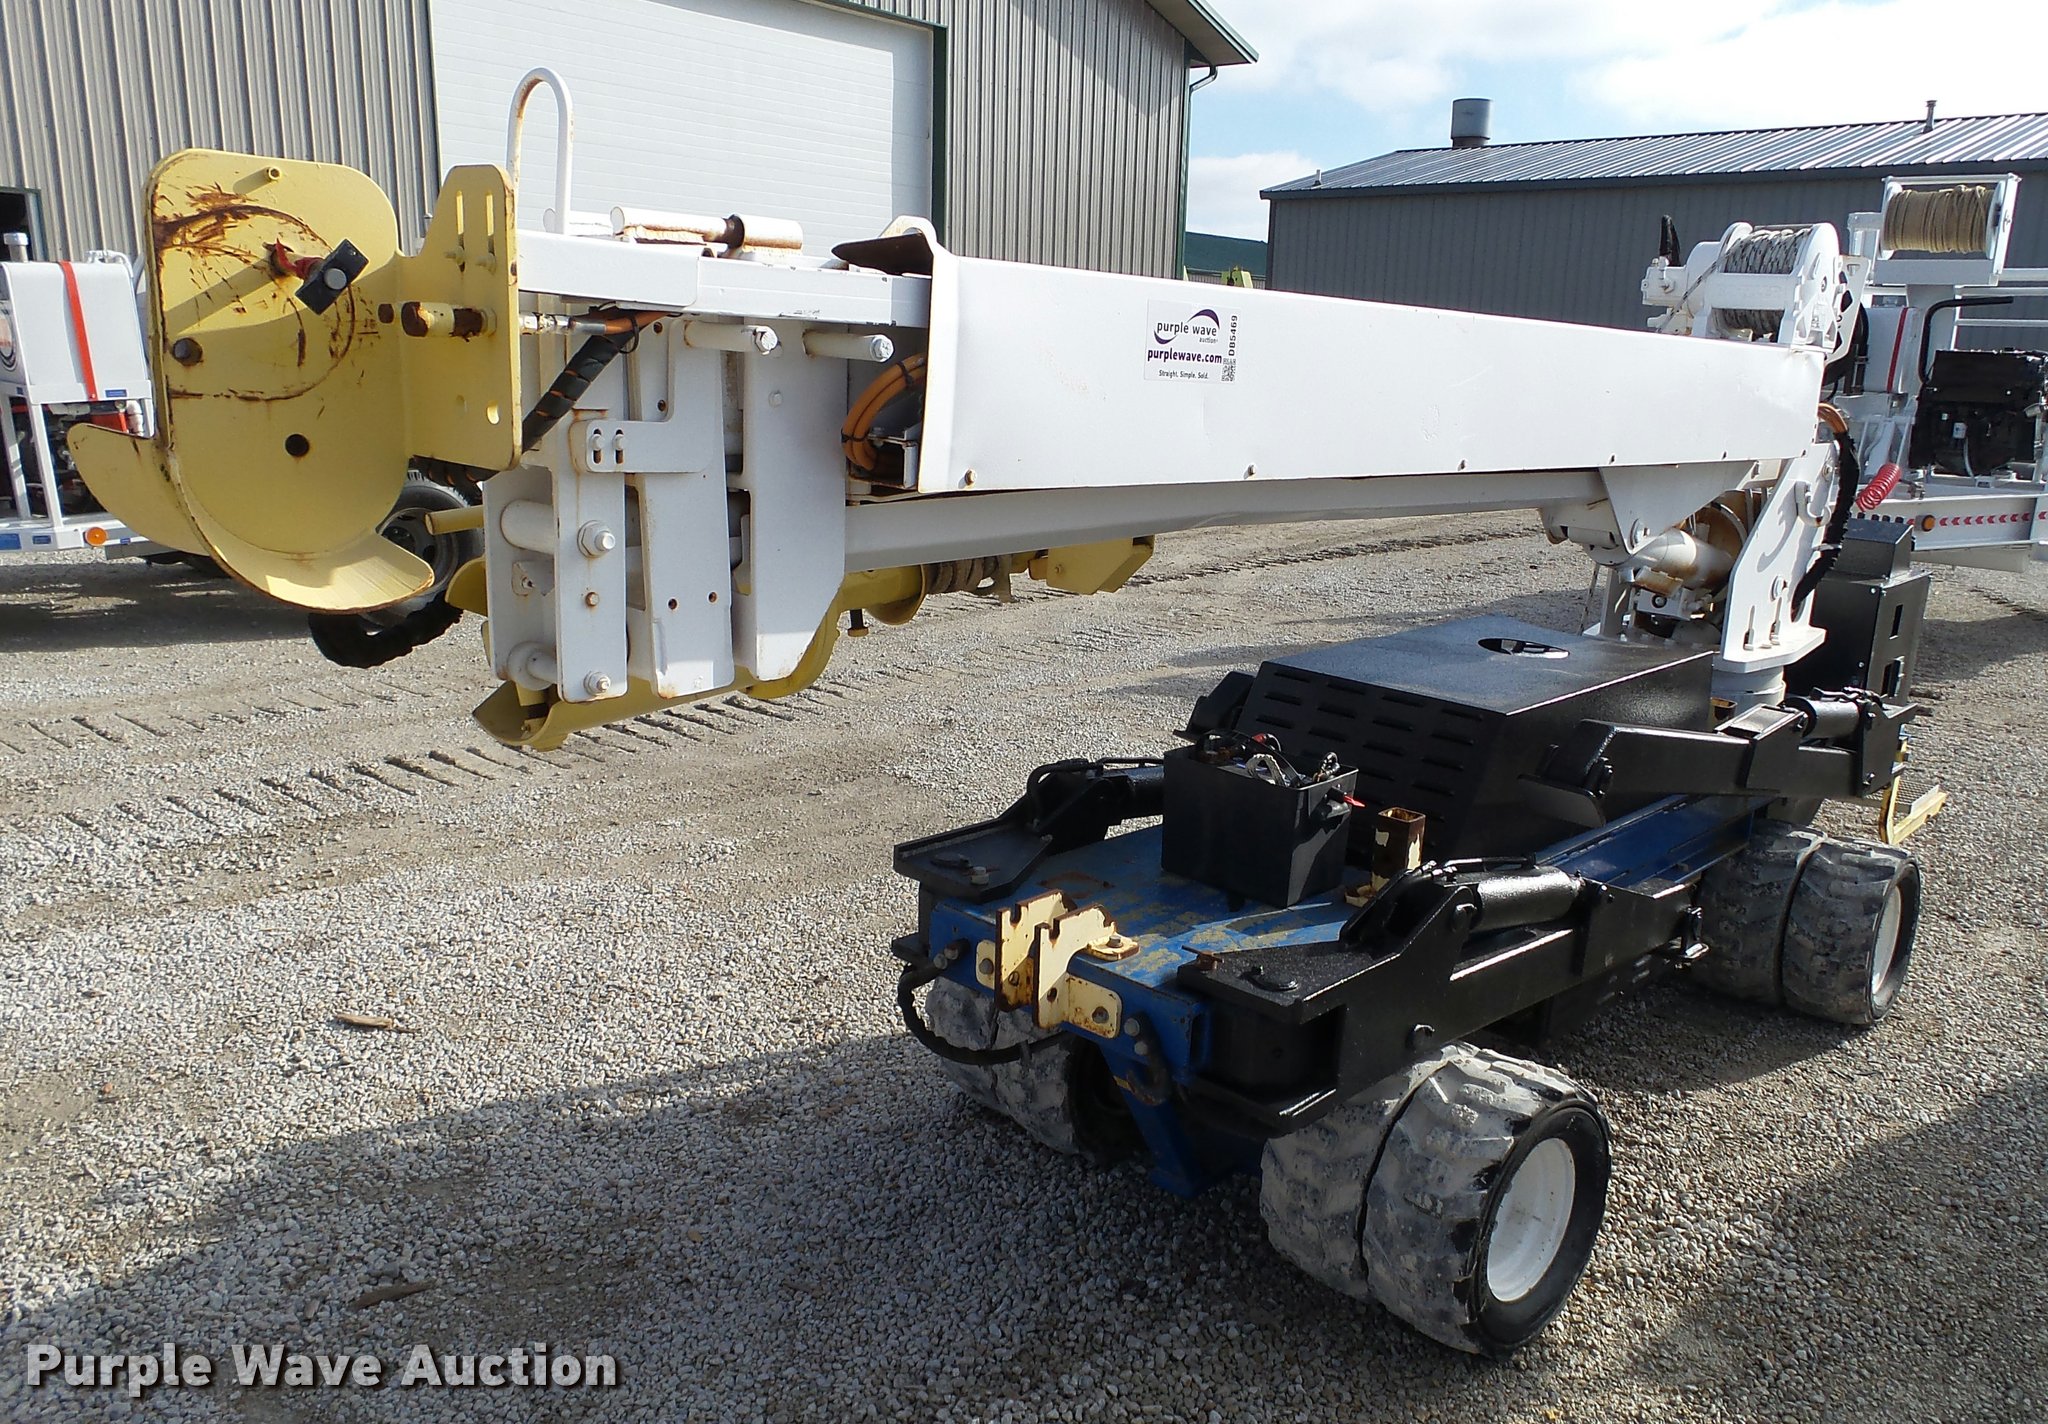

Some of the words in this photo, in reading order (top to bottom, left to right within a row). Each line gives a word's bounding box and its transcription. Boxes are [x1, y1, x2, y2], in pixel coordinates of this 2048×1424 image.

[1157, 322, 1189, 335] purple
[1192, 326, 1217, 336] wave
[1228, 315, 1237, 356] DB5469
[1147, 348, 1222, 363] purplewave.com
[1159, 370, 1178, 379] Straight.
[1180, 371, 1196, 379] Simple.
